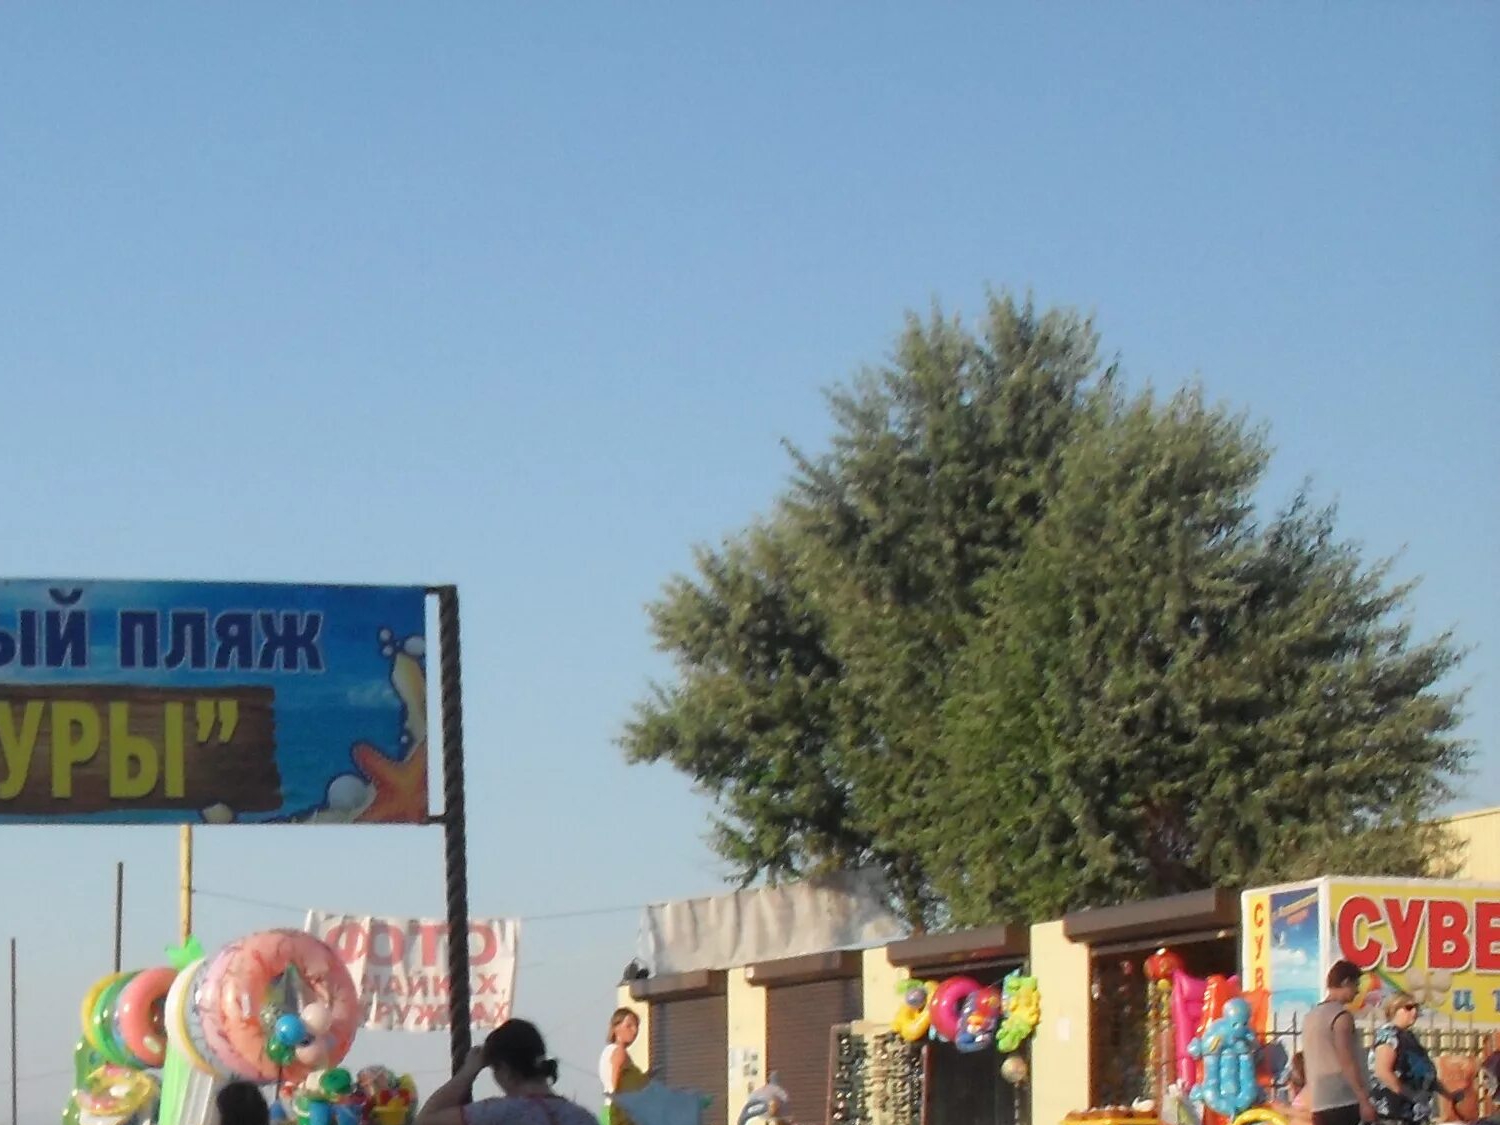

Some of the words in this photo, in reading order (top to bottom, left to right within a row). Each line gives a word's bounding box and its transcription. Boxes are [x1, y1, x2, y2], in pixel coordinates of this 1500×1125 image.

[119, 609, 325, 671] пляж
[326, 919, 498, 967] ФОТО
[359, 1002, 510, 1025] РУЖАХ
